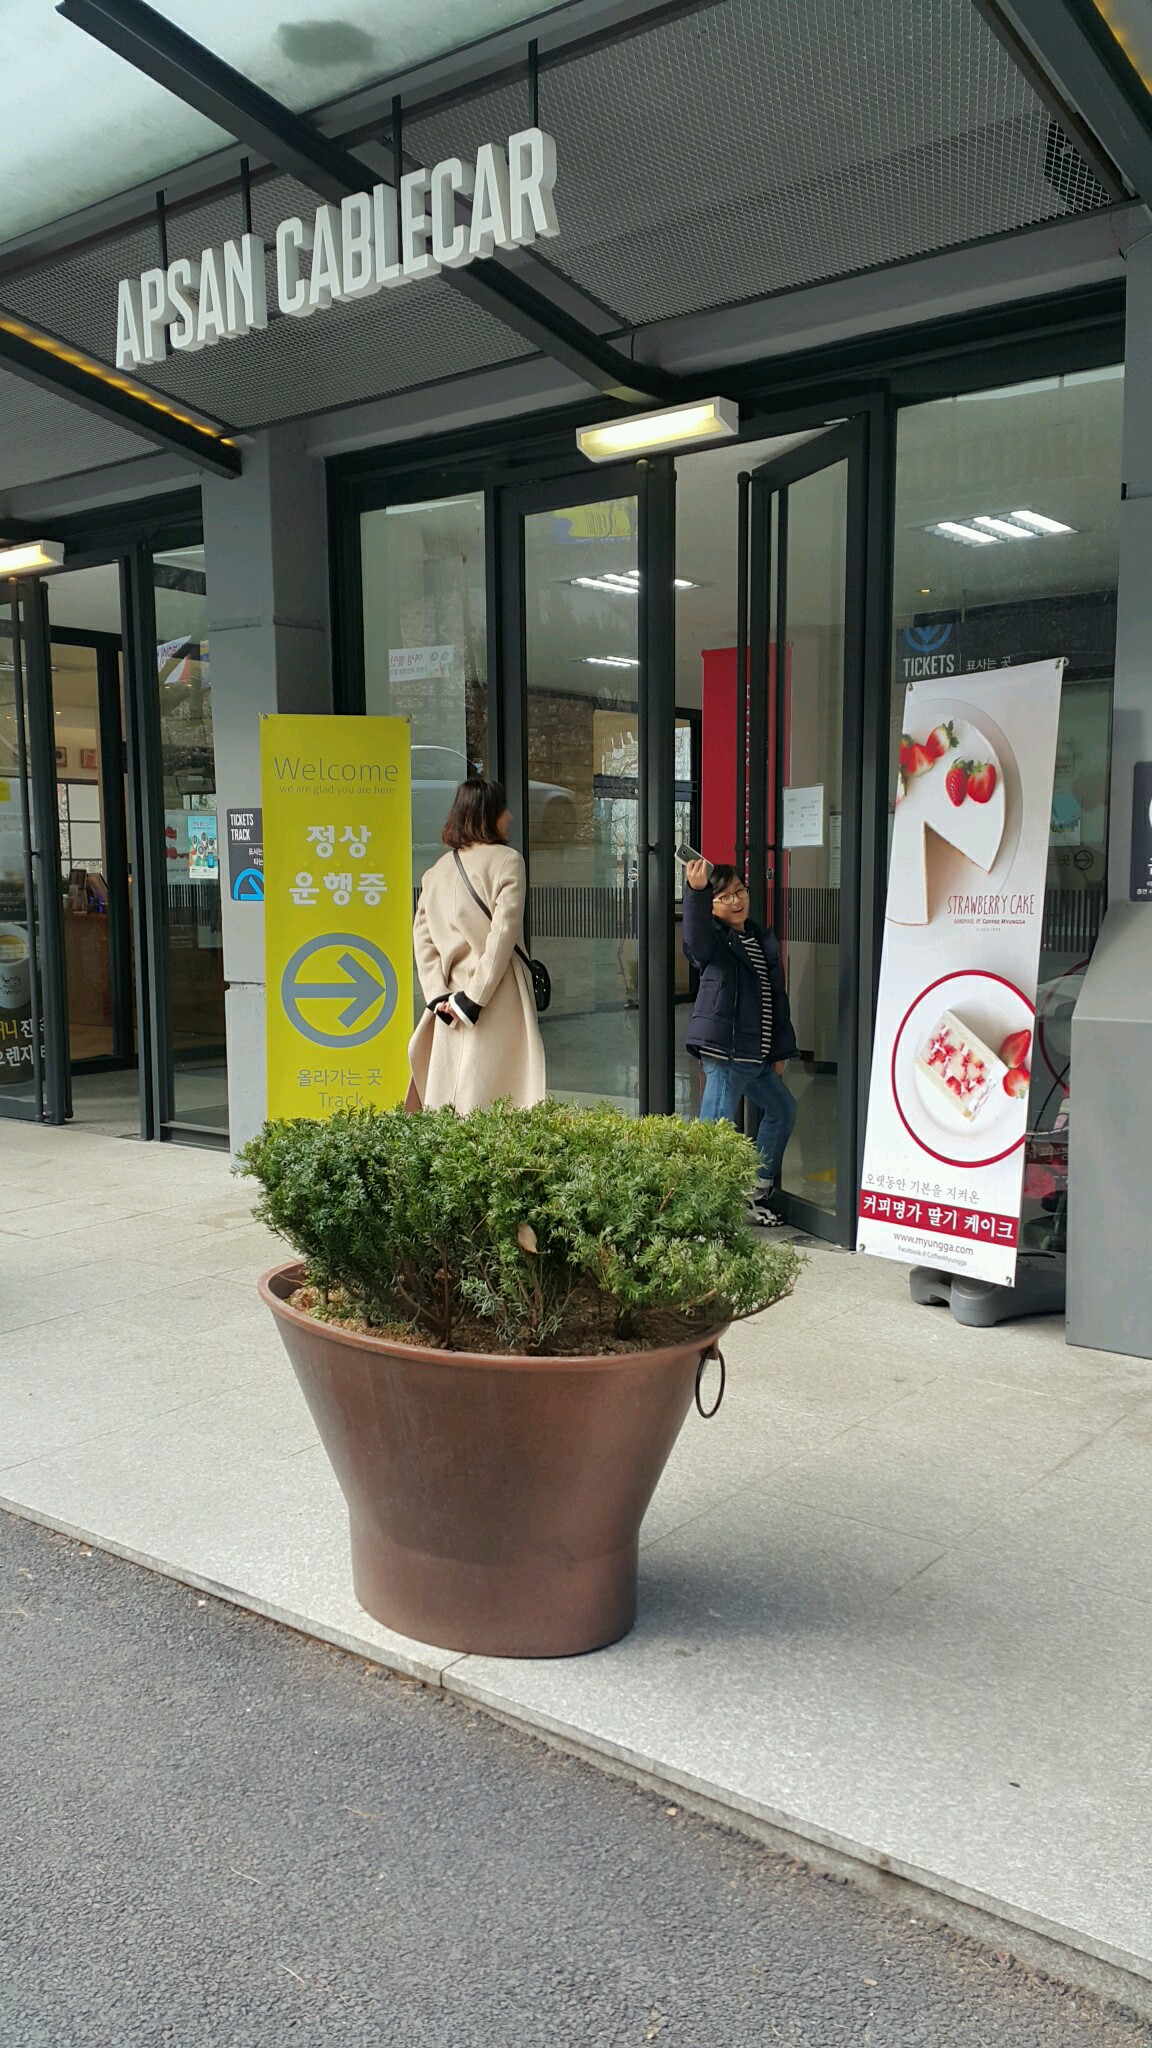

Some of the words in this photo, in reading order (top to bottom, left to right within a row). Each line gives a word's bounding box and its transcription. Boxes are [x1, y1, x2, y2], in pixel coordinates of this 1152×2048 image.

[116, 232, 267, 370] APSAN
[276, 127, 560, 316] CABLECAR
[903, 653, 955, 677] TICKETS
[966, 657, 997, 671] 표사는
[274, 757, 398, 782] Welcome
[280, 785, 292, 793] we
[296, 785, 311, 793] are
[314, 784, 334, 796] glad
[337, 785, 354, 795] you
[357, 786, 371, 794] are
[374, 785, 395, 794] here
[230, 813, 254, 827] TICKETS
[231, 828, 251, 841] TRACK
[306, 825, 371, 858] 정상
[289, 872, 387, 906] 운행중
[948, 895, 1008, 915] STRAWBERRY
[1010, 894, 1035, 915] CAKE
[297, 1069, 362, 1087] 올라가는
[366, 1068, 382, 1086] 곳
[318, 1091, 364, 1108] Track
[865, 1173, 906, 1191] 오랫동안
[911, 1180, 943, 1198] 기본을
[946, 1186, 980, 1205] 지켜온
[863, 1194, 922, 1223] 커피명가
[928, 1206, 957, 1230] 딸기
[964, 1214, 1015, 1240] 케이크
[894, 1232, 974, 1255] www.myungga.com
